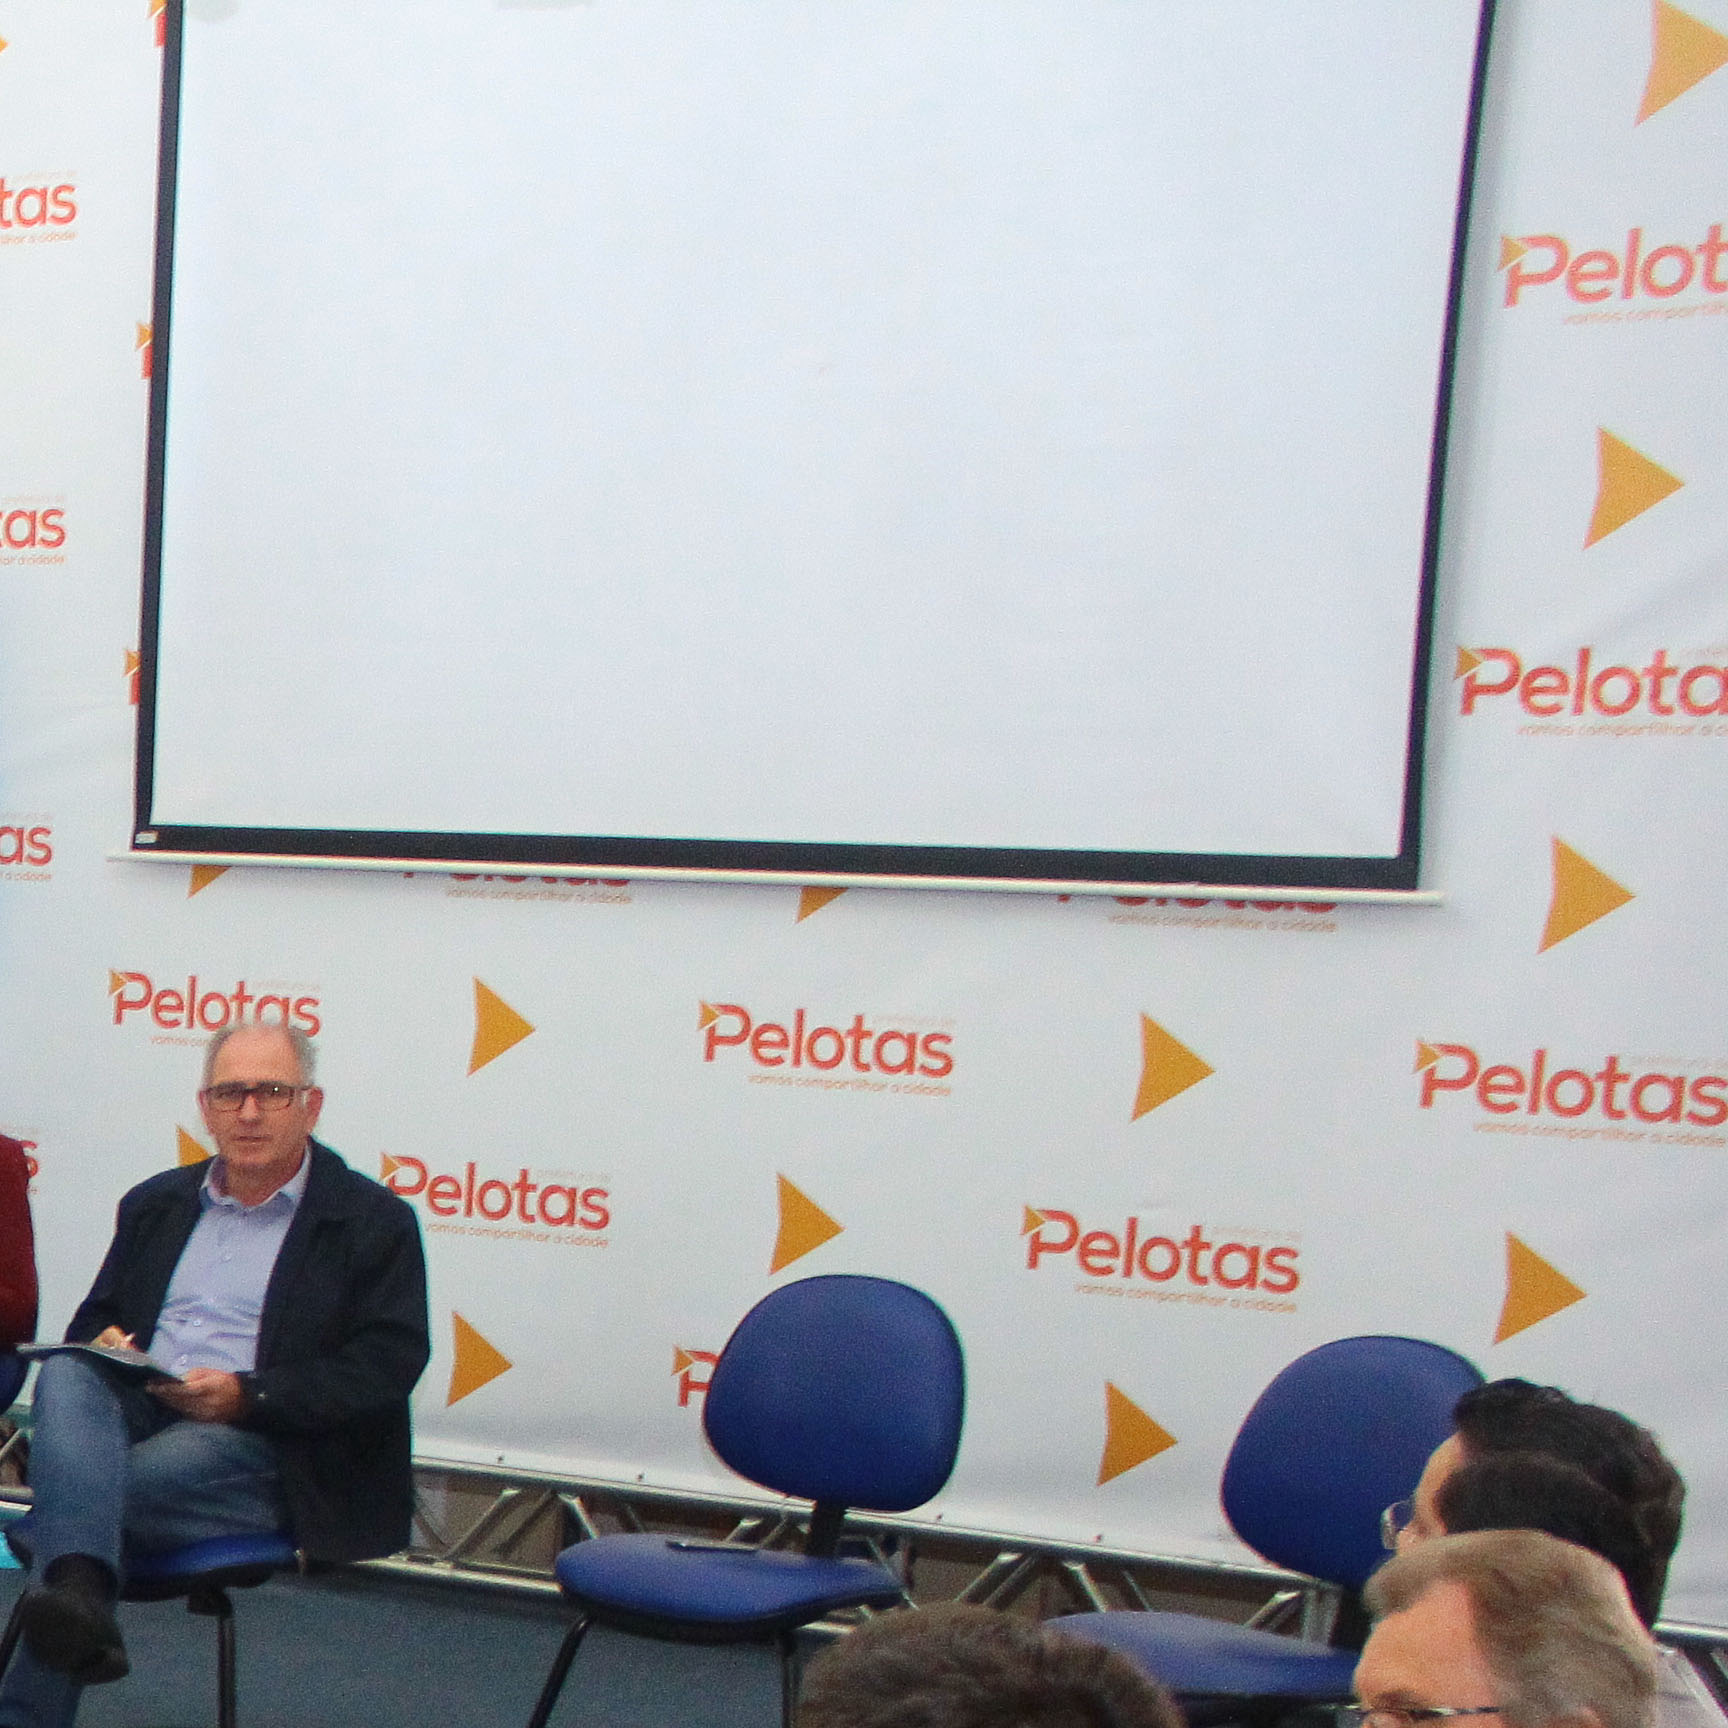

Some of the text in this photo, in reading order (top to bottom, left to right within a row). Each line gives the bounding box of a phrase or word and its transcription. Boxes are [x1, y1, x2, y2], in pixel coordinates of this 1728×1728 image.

[1498, 224, 1728, 308] Pelot
[1453, 647, 1728, 717] Pelota
[109, 970, 321, 1037] Pelotas
[697, 1000, 953, 1078] Pelotas
[1413, 1040, 1728, 1126] Pelotas
[380, 1153, 610, 1230] Pelotas
[1021, 1205, 1300, 1294] Pelotas
